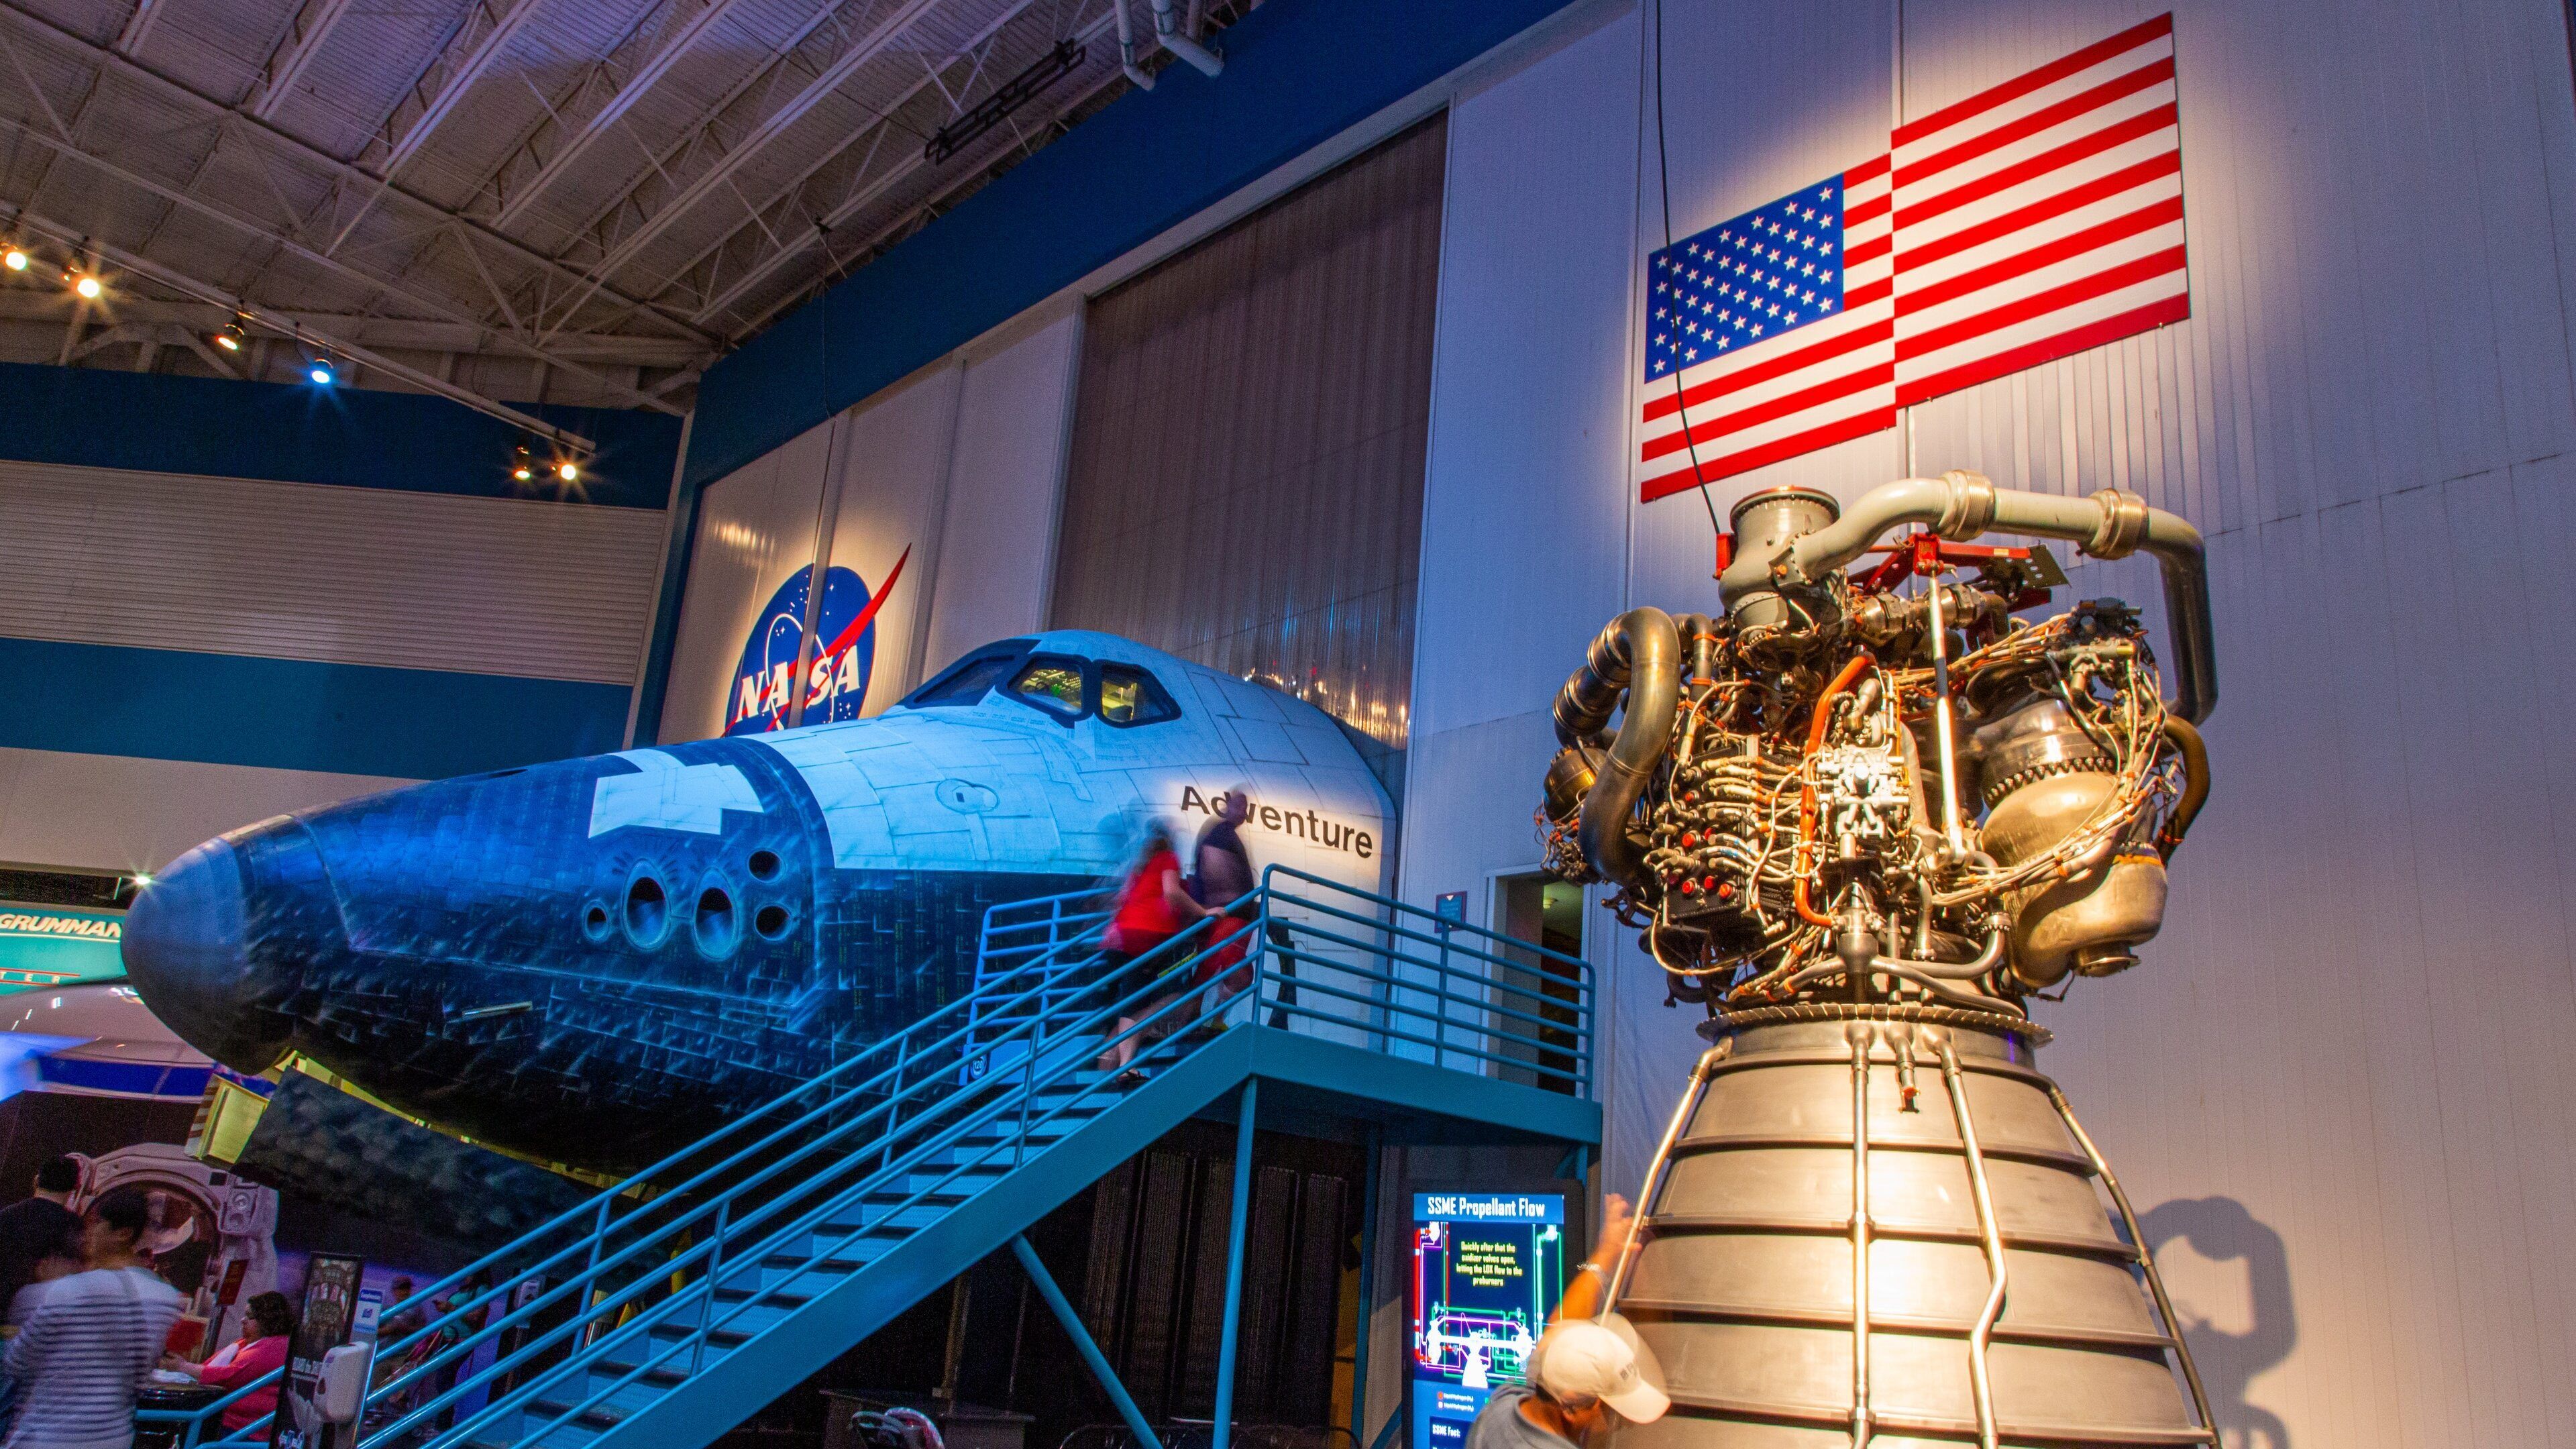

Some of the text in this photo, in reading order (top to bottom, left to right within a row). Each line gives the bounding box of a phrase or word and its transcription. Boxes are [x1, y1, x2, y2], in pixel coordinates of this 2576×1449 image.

[735, 645, 860, 723] NASA
[1181, 786, 1373, 859] Adventure
[1428, 1197, 1545, 1220] SSME Propellant Flow
[1495, 1242, 1505, 1252] that
[1507, 1243, 1515, 1253] the
[1474, 1264, 1483, 1274] the
[1483, 1265, 1493, 1274] LOX
[1494, 1265, 1505, 1275] flow
[1507, 1267, 1512, 1275] to
[1513, 1266, 1522, 1276] the
[1432, 1424, 1447, 1436] SSME
